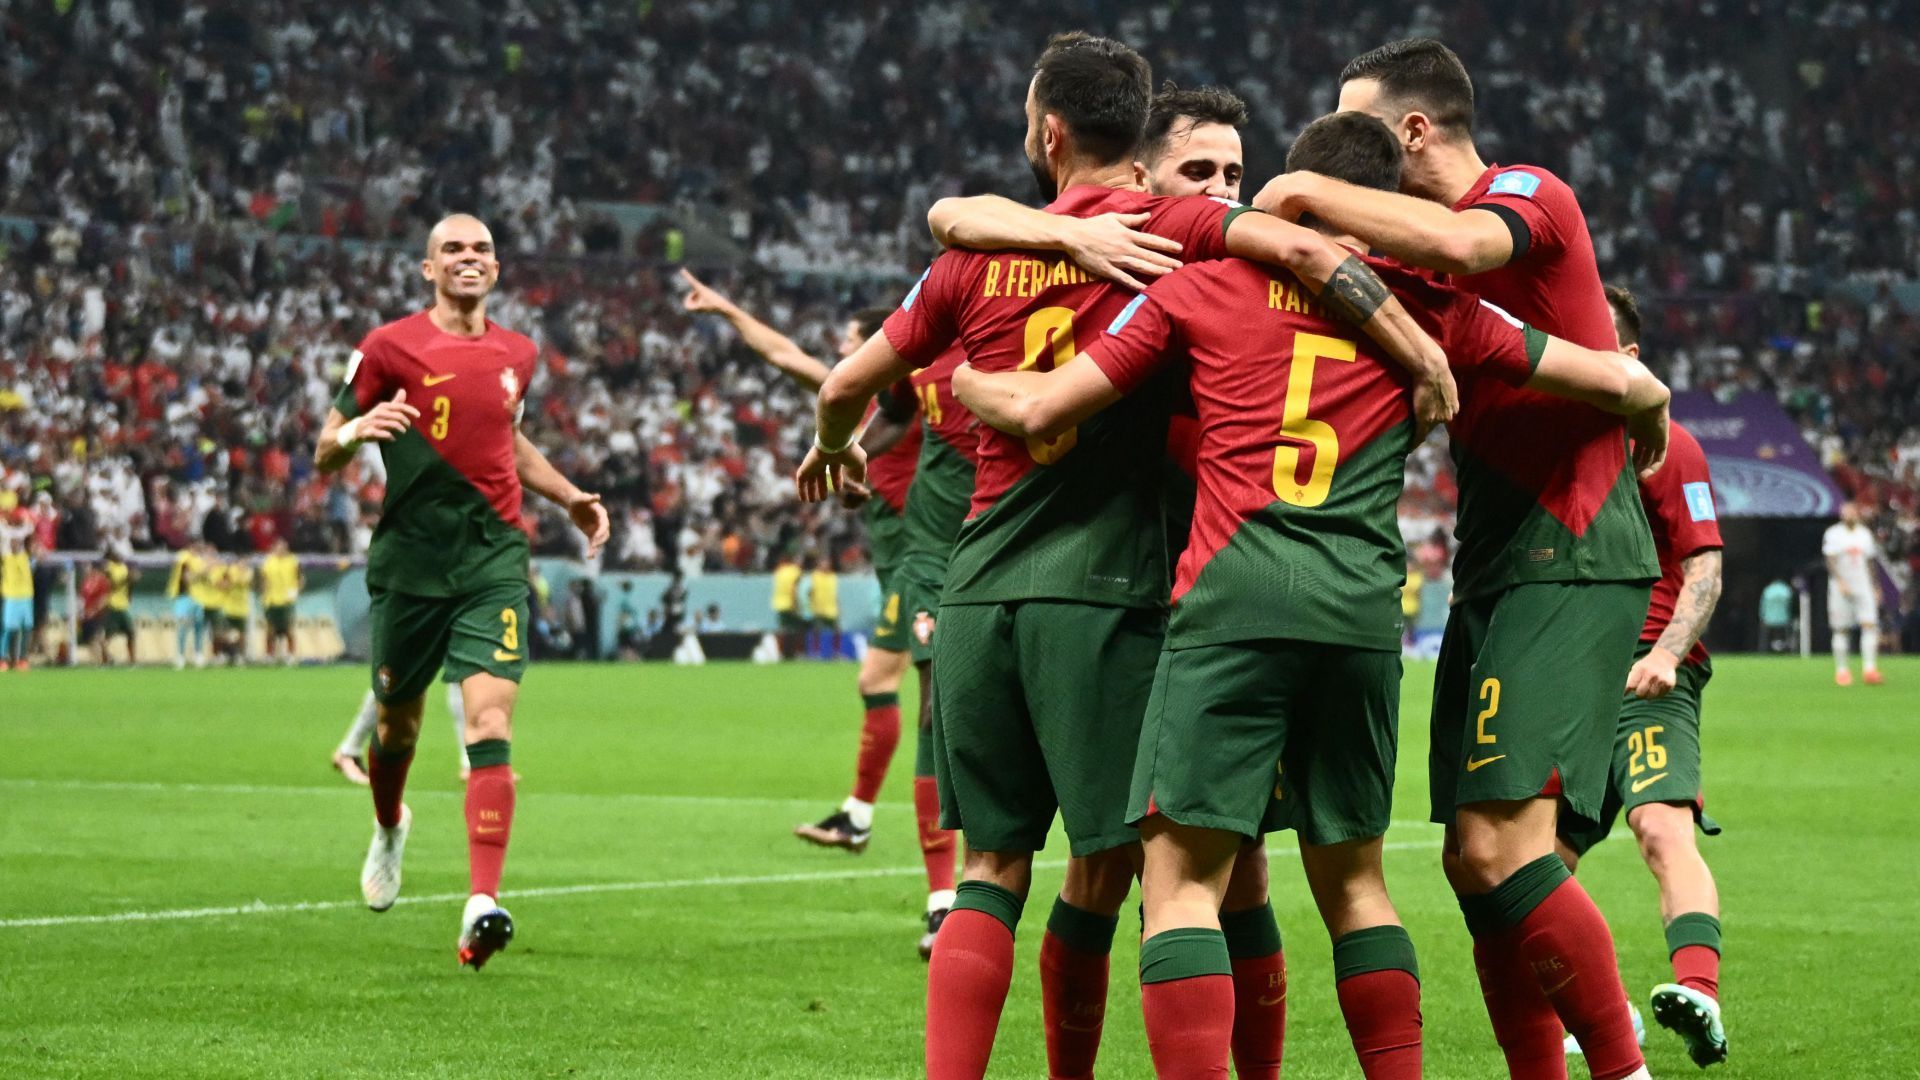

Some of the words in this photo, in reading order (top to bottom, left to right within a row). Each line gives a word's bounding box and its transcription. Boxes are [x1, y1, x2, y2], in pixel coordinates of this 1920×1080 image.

[430, 395, 451, 441] 3
[1272, 331, 1357, 508] 5
[501, 607, 519, 651] 3
[1476, 677, 1501, 745] 2
[1627, 725, 1668, 777] 25
